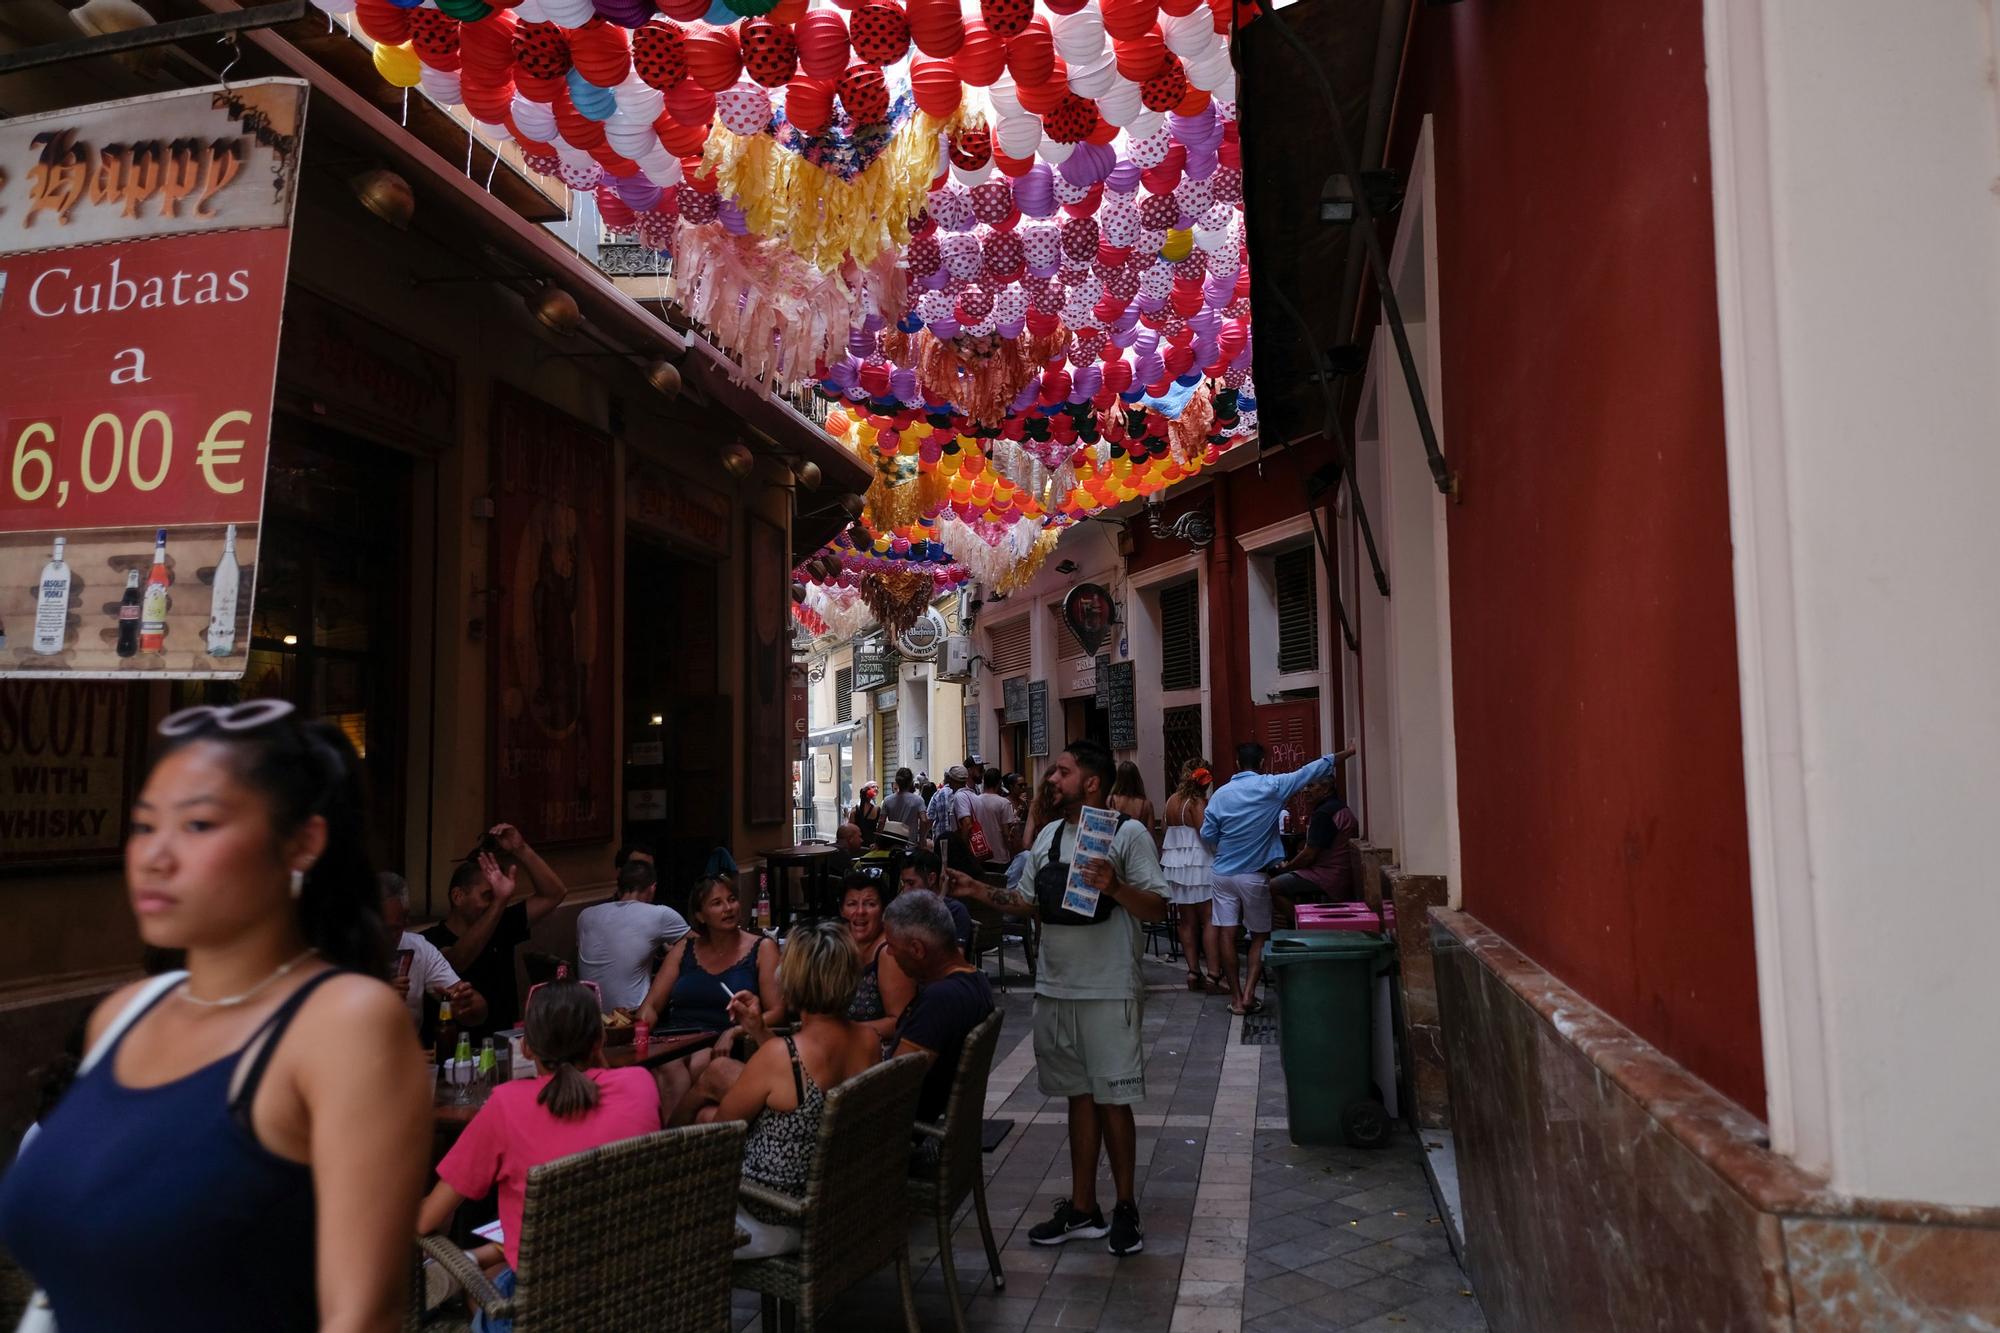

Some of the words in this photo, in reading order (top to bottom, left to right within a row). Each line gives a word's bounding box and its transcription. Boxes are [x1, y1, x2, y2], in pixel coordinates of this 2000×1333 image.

[24, 127, 243, 229] Happy
[29, 258, 250, 318] Cubatas
[110, 347, 151, 385] a
[11, 410, 173, 508] 6,00
[196, 410, 252, 494] €
[0, 681, 125, 757] SCOTT
[11, 767, 88, 793] WITH
[0, 809, 108, 839] WHISKY
